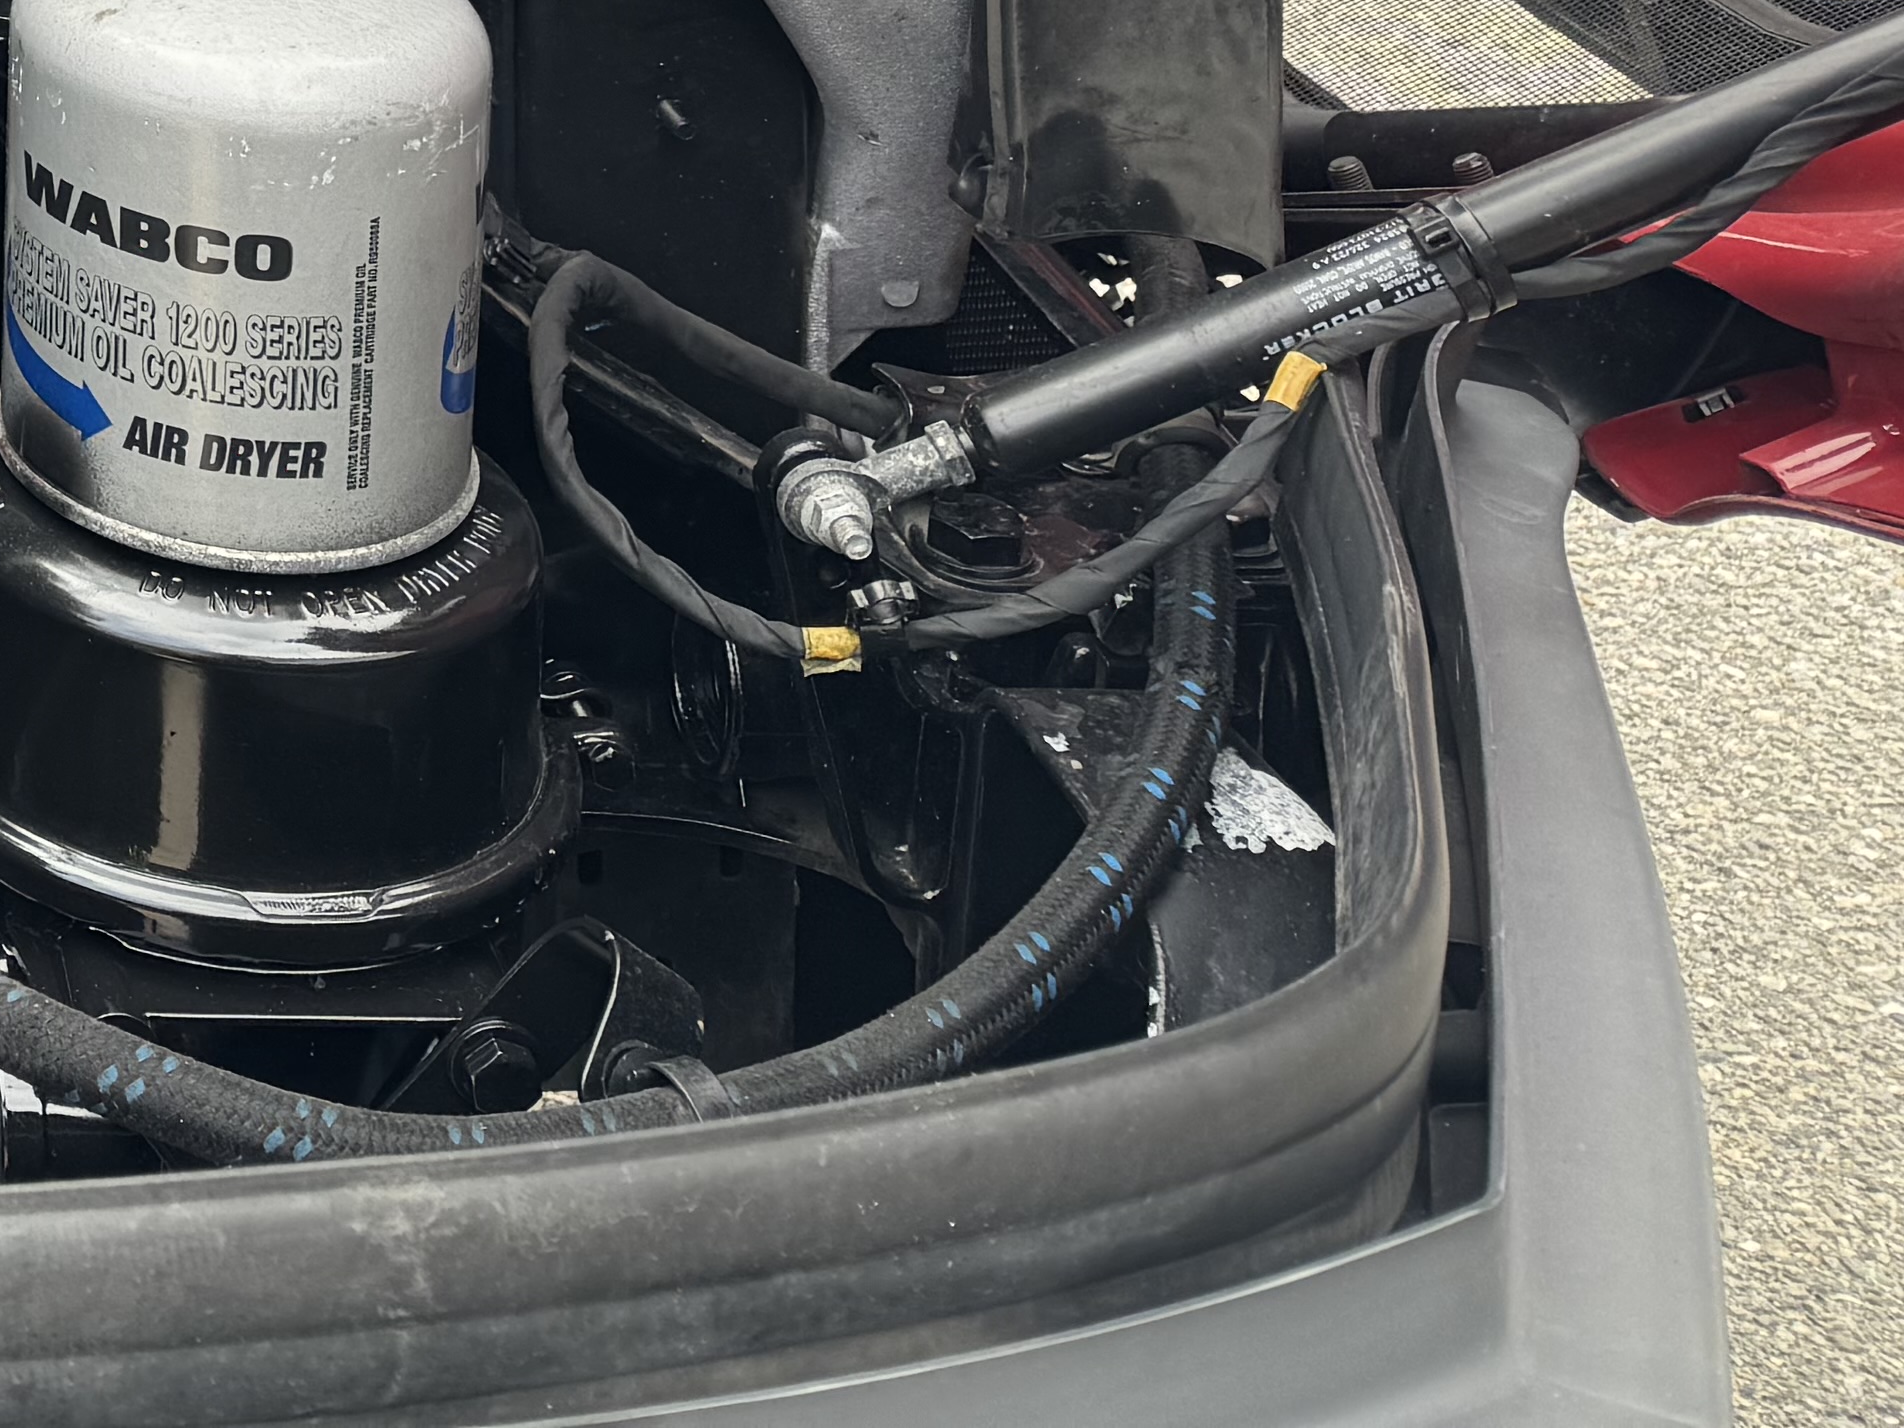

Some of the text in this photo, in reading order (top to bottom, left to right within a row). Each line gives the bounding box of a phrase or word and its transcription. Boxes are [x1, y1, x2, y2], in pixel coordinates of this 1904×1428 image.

[22, 148, 295, 283] WABCO
[10, 215, 344, 362] SYSTEM SAVER 1200 SERIES
[355, 262, 367, 278] OIL
[354, 279, 366, 323] PREMIUM
[366, 285, 378, 308] PART
[9, 264, 341, 412] PREMIUM OIL COALESCING
[353, 324, 364, 358] WABCO
[364, 310, 376, 364] CARTRIDGE
[351, 362, 363, 401] GENUINE
[361, 368, 374, 432] REPLACEMENT
[350, 401, 361, 427] WITH
[121, 414, 329, 480] AIR DRYER
[138, 570, 393, 619] DO NOT OPEN
